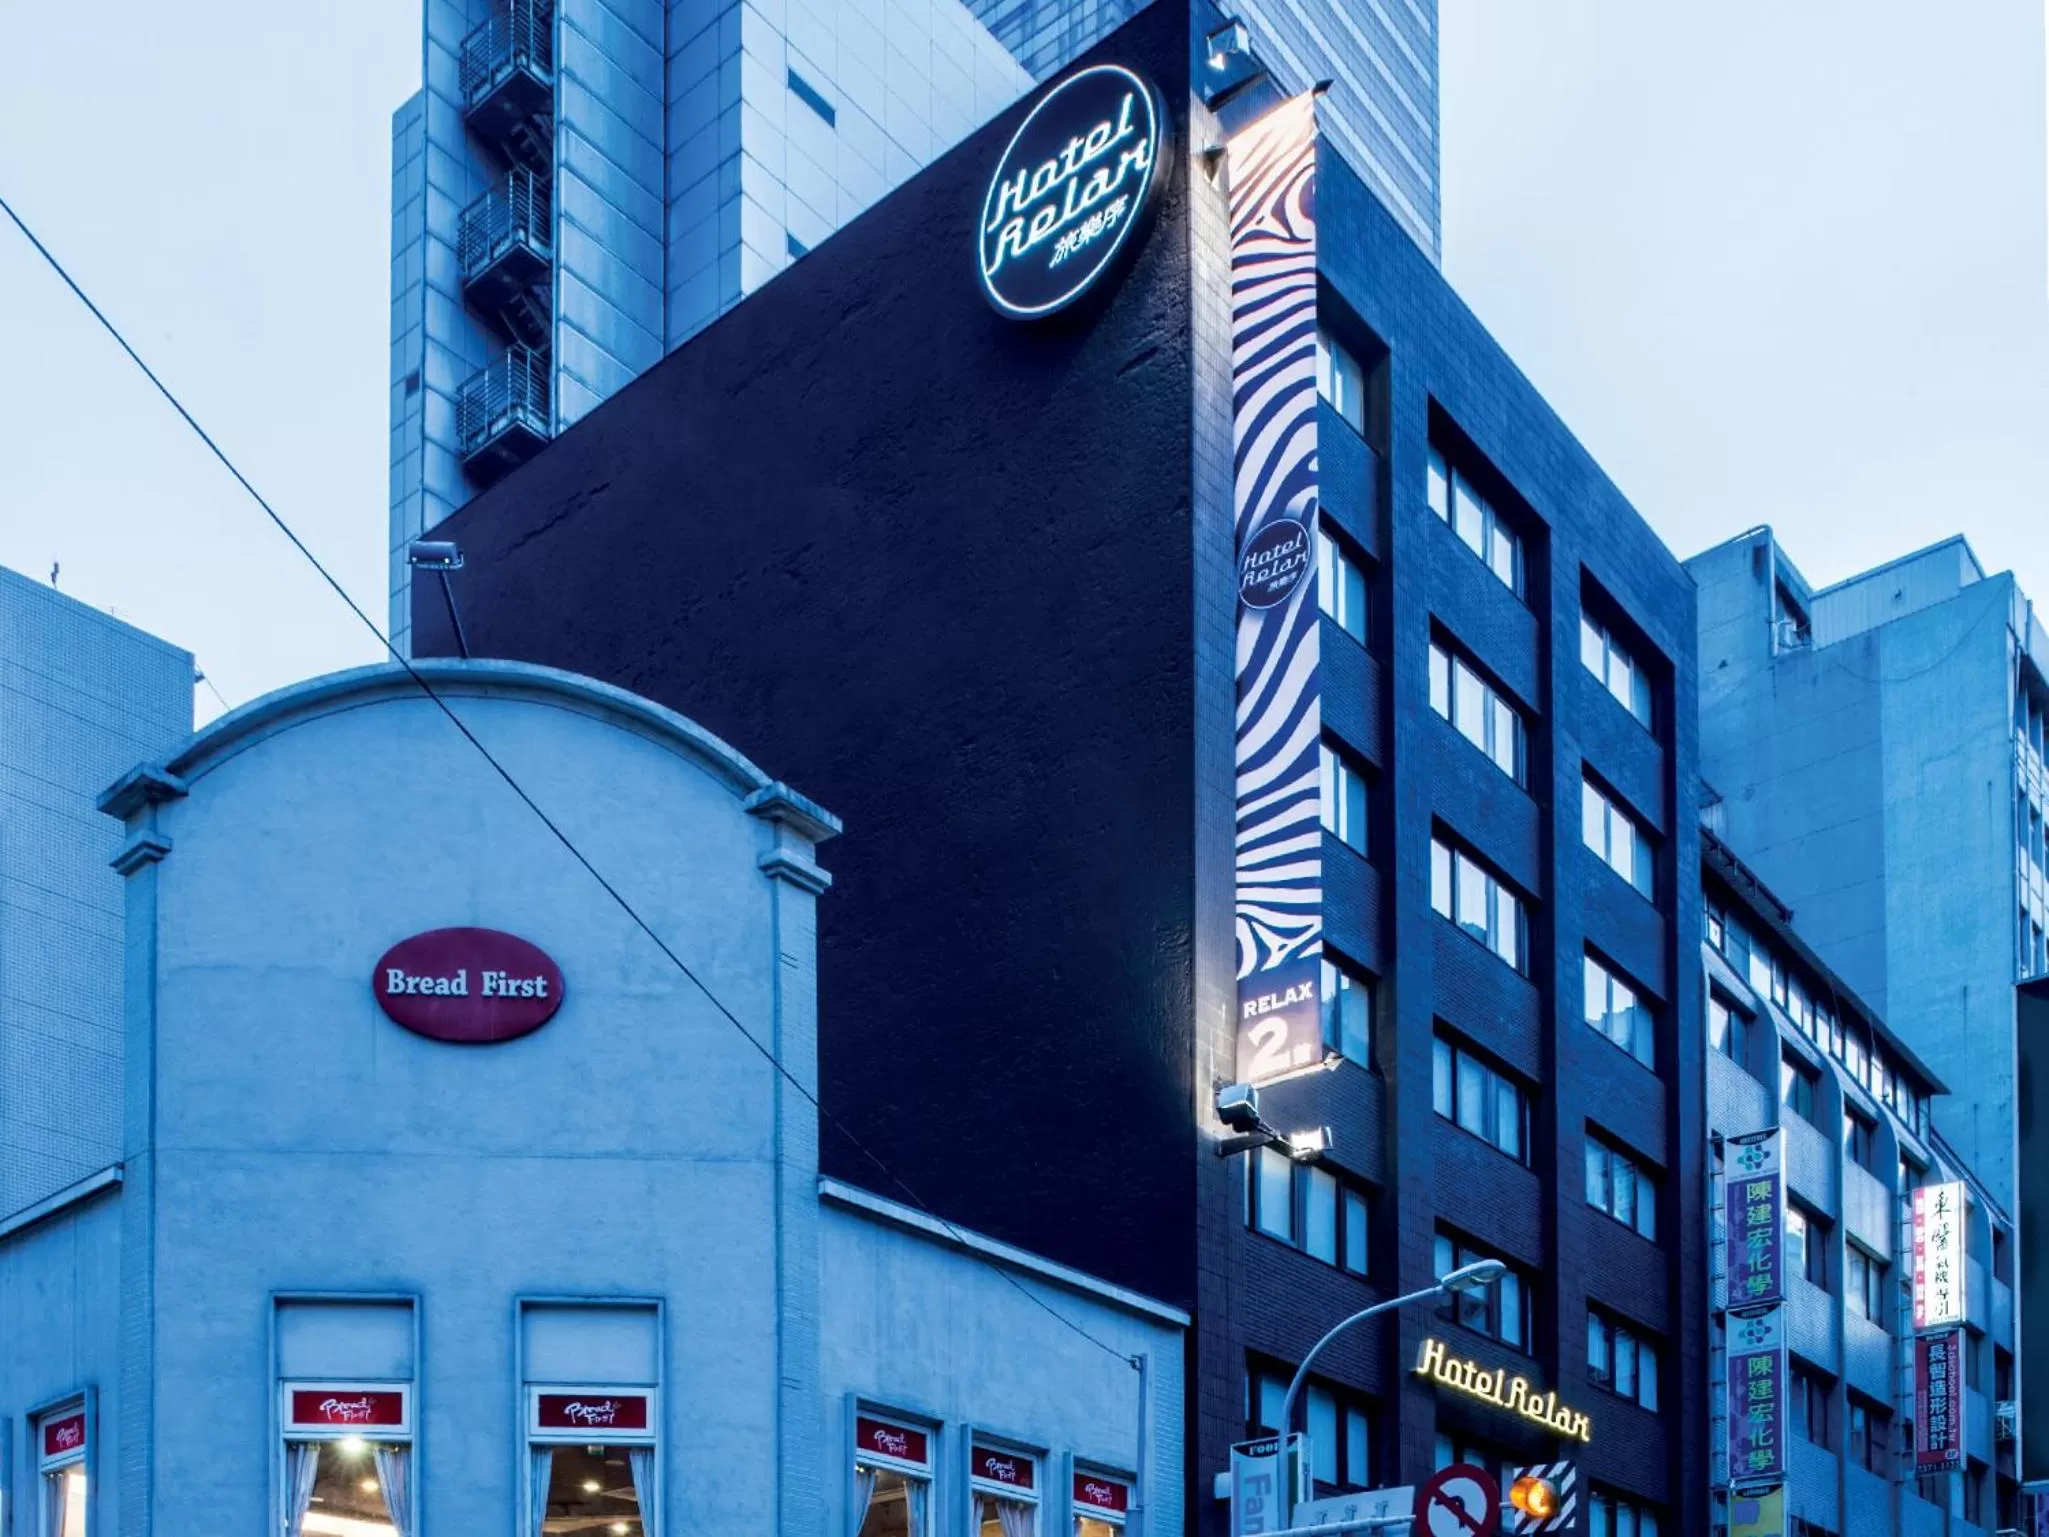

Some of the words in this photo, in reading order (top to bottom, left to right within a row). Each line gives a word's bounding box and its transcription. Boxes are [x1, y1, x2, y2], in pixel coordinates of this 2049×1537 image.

[987, 93, 1134, 232] Hotel
[986, 137, 1148, 277] Relax
[1240, 550, 1307, 592] Relax
[1242, 530, 1303, 575] Hotel
[386, 968, 469, 996] Bread
[481, 971, 548, 998] First
[1243, 980, 1314, 1020] RELAX
[1248, 1016, 1292, 1080] 2
[1746, 1179, 1774, 1297] 陳建宏化學
[1416, 1338, 1505, 1405] Hotel
[1504, 1376, 1591, 1443] Relax
[1747, 1355, 1775, 1472] 陳建宏化學
